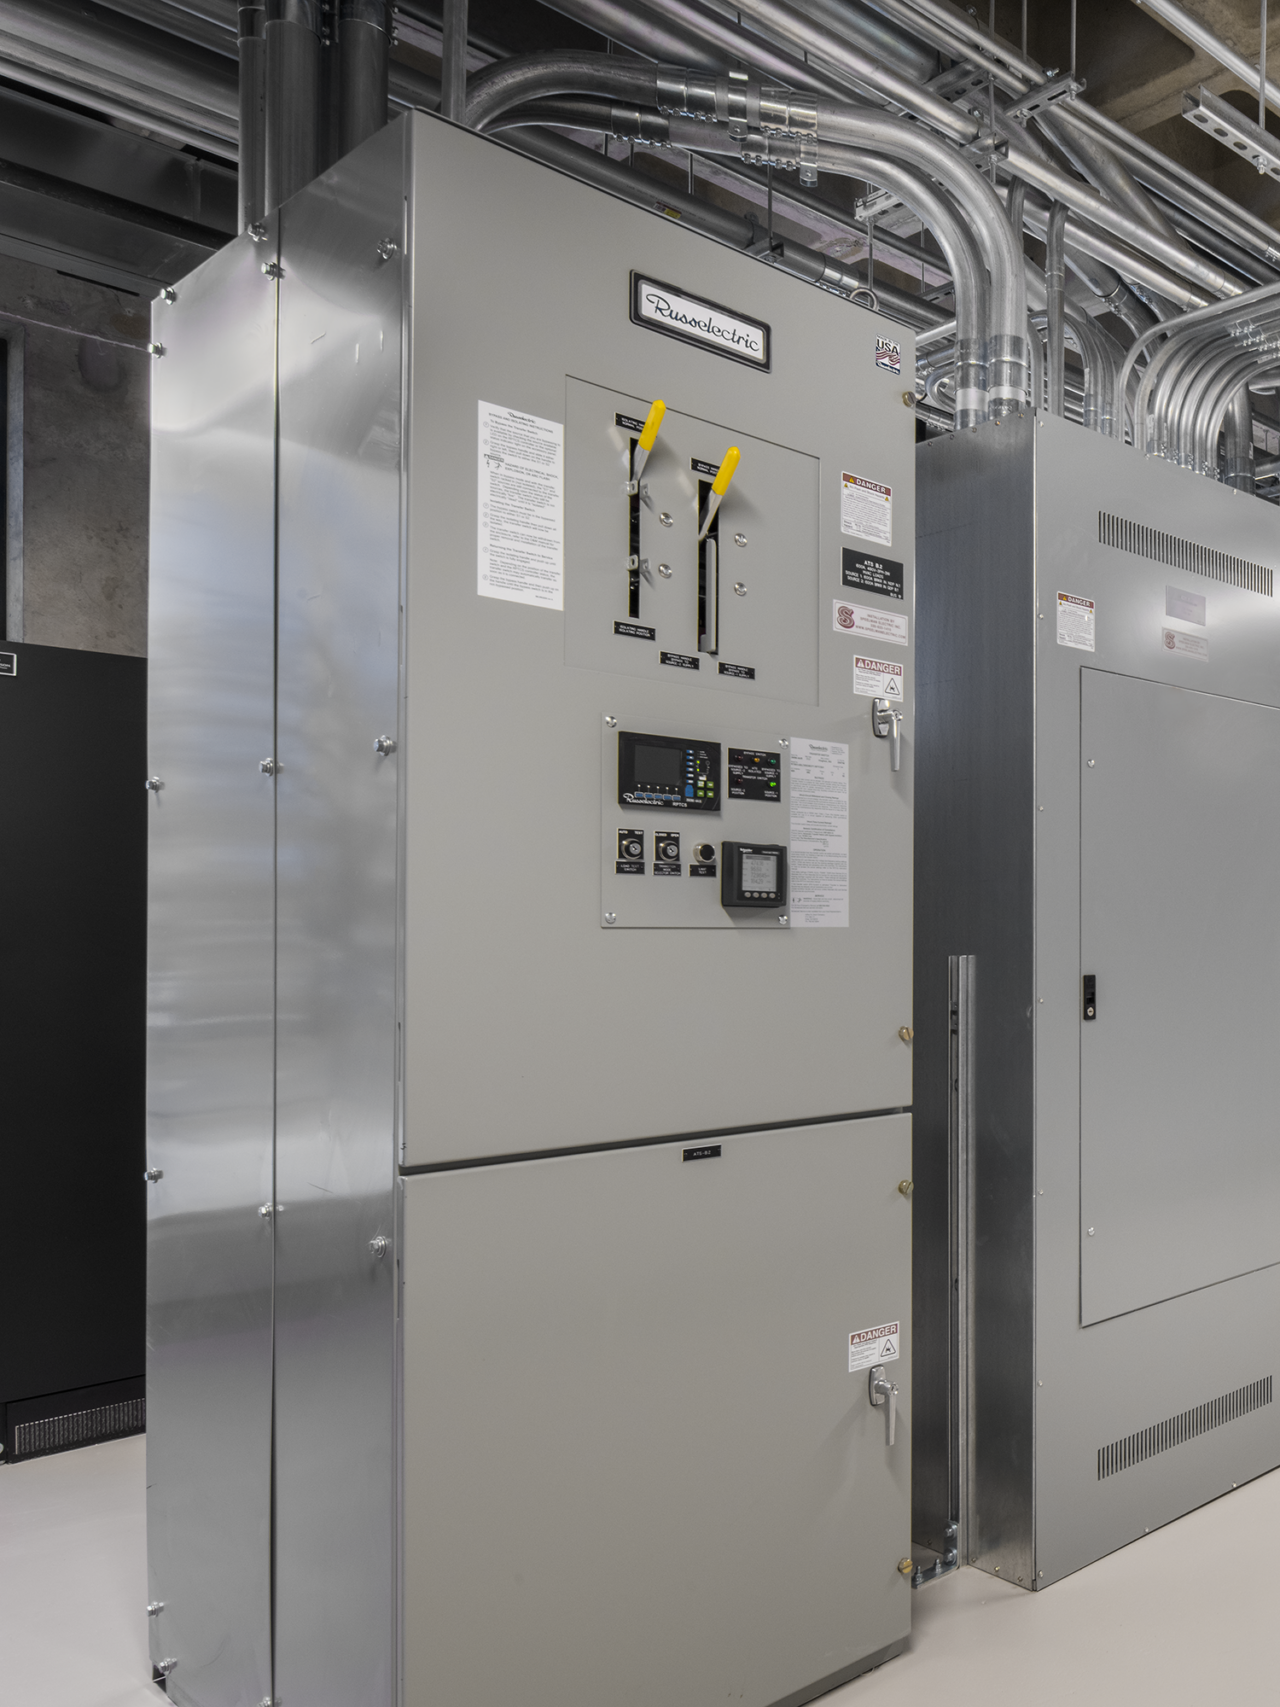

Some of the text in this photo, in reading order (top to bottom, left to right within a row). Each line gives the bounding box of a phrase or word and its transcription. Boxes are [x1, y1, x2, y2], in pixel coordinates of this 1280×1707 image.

[646, 294, 759, 351] Russelectric
[877, 339, 898, 355] USA
[857, 479, 886, 493] DANGER
[1068, 597, 1090, 607] DANGER
[866, 660, 900, 675] DANGER
[860, 1325, 896, 1342] DANGER
